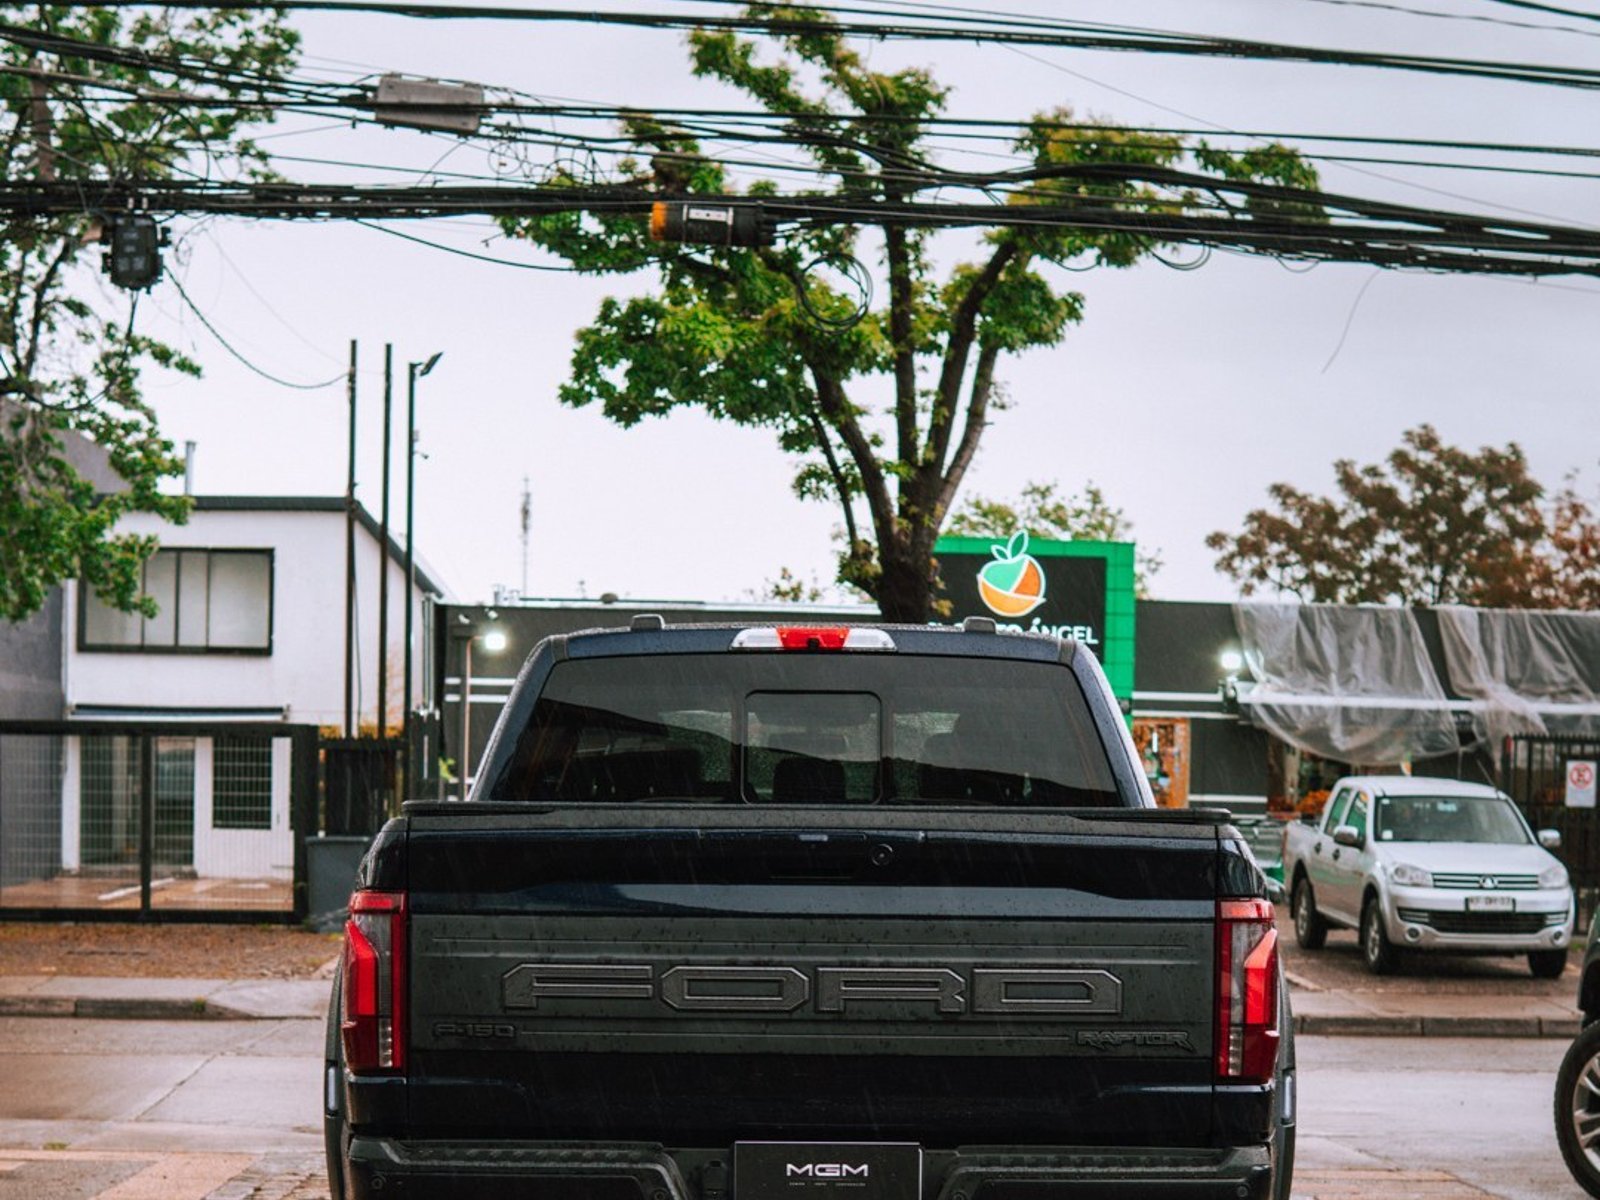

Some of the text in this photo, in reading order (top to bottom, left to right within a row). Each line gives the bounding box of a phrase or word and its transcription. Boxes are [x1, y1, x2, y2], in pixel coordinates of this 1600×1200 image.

[503, 963, 1122, 1013] FORD
[434, 1023, 516, 1038] F-150
[1077, 1030, 1196, 1053] RAPTOR
[786, 1163, 868, 1177] MGM
